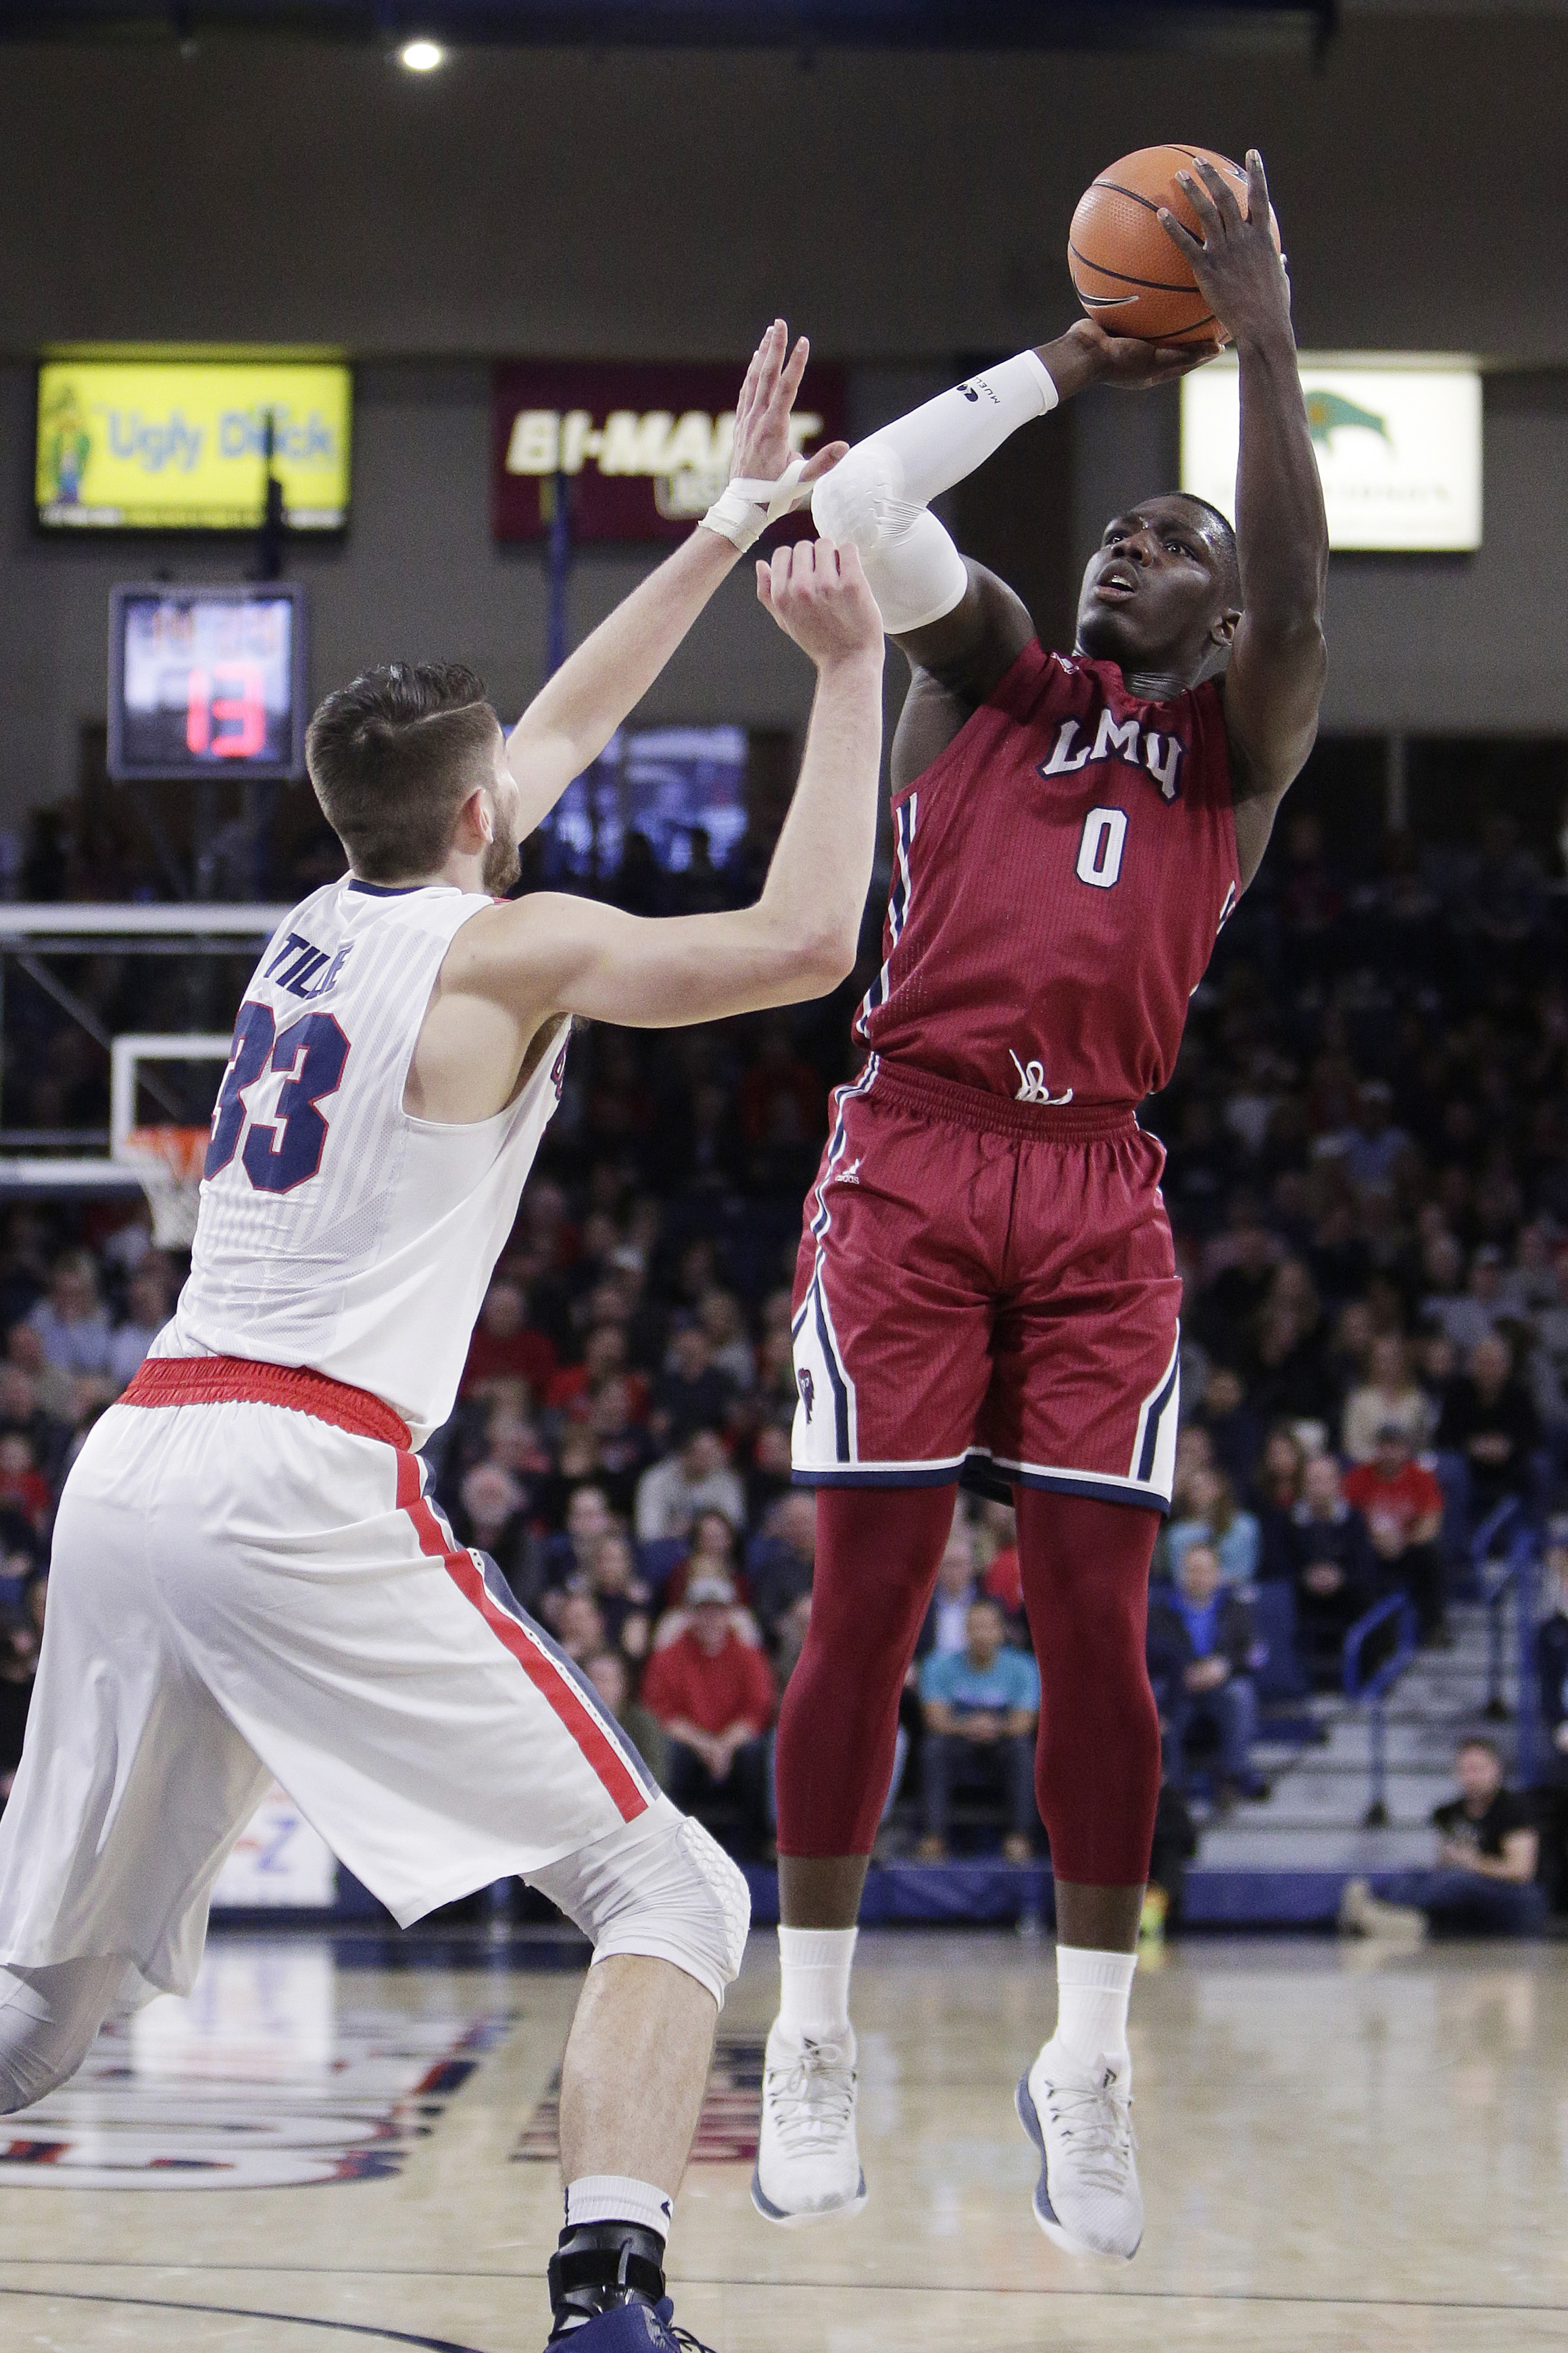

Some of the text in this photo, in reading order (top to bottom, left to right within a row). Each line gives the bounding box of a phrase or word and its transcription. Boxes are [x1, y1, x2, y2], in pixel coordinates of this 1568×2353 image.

[107, 406, 202, 473] Ugly
[505, 408, 824, 475] BI-MAT
[187, 661, 265, 758] 13
[1038, 706, 1186, 805] LMU
[1076, 806, 1129, 890] 0
[203, 1000, 351, 1194] 33
